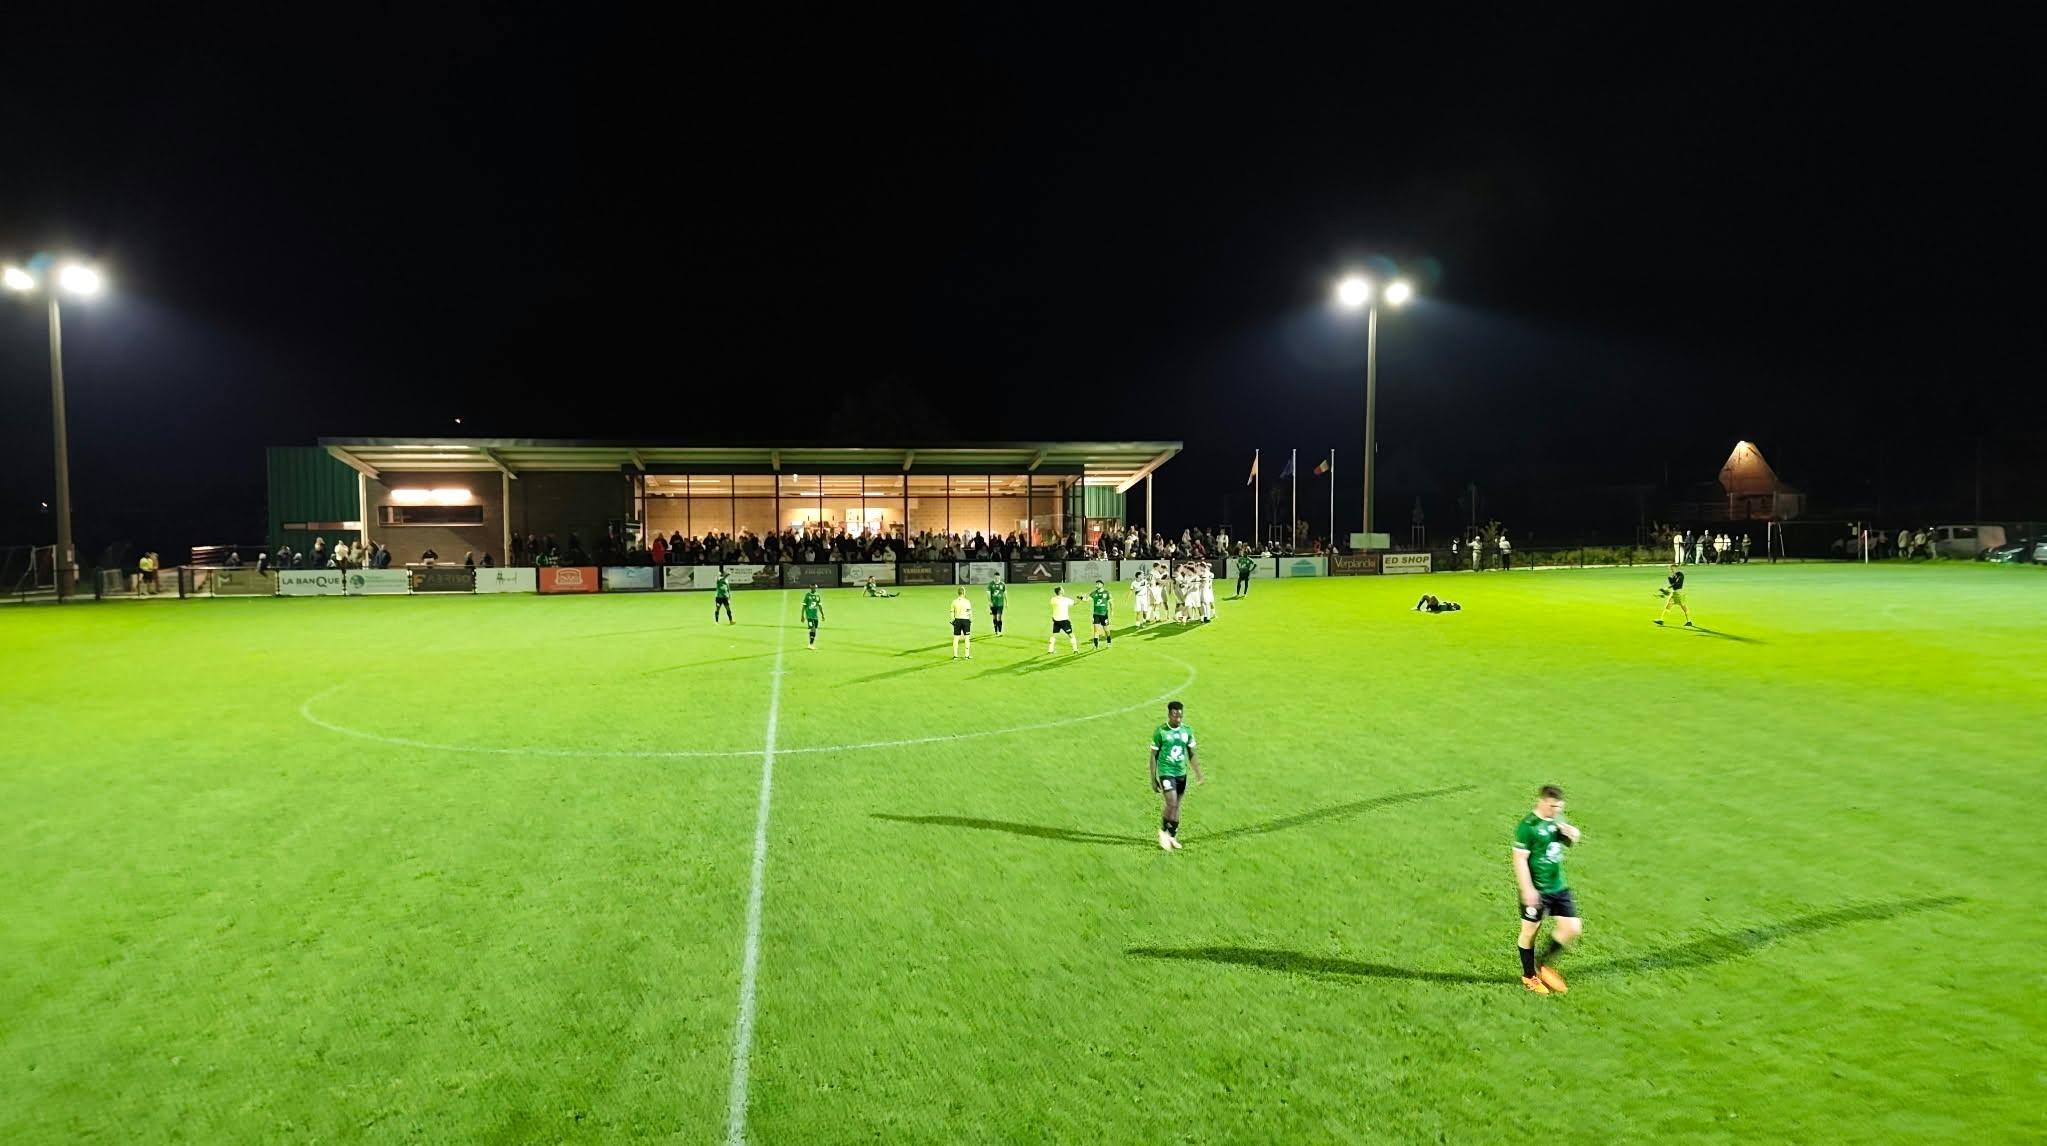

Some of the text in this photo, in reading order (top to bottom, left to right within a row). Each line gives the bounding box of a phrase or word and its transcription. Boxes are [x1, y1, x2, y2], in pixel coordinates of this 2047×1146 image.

[1384, 555, 1430, 565] ED SHOP
[282, 576, 340, 587] LA BANQUE
